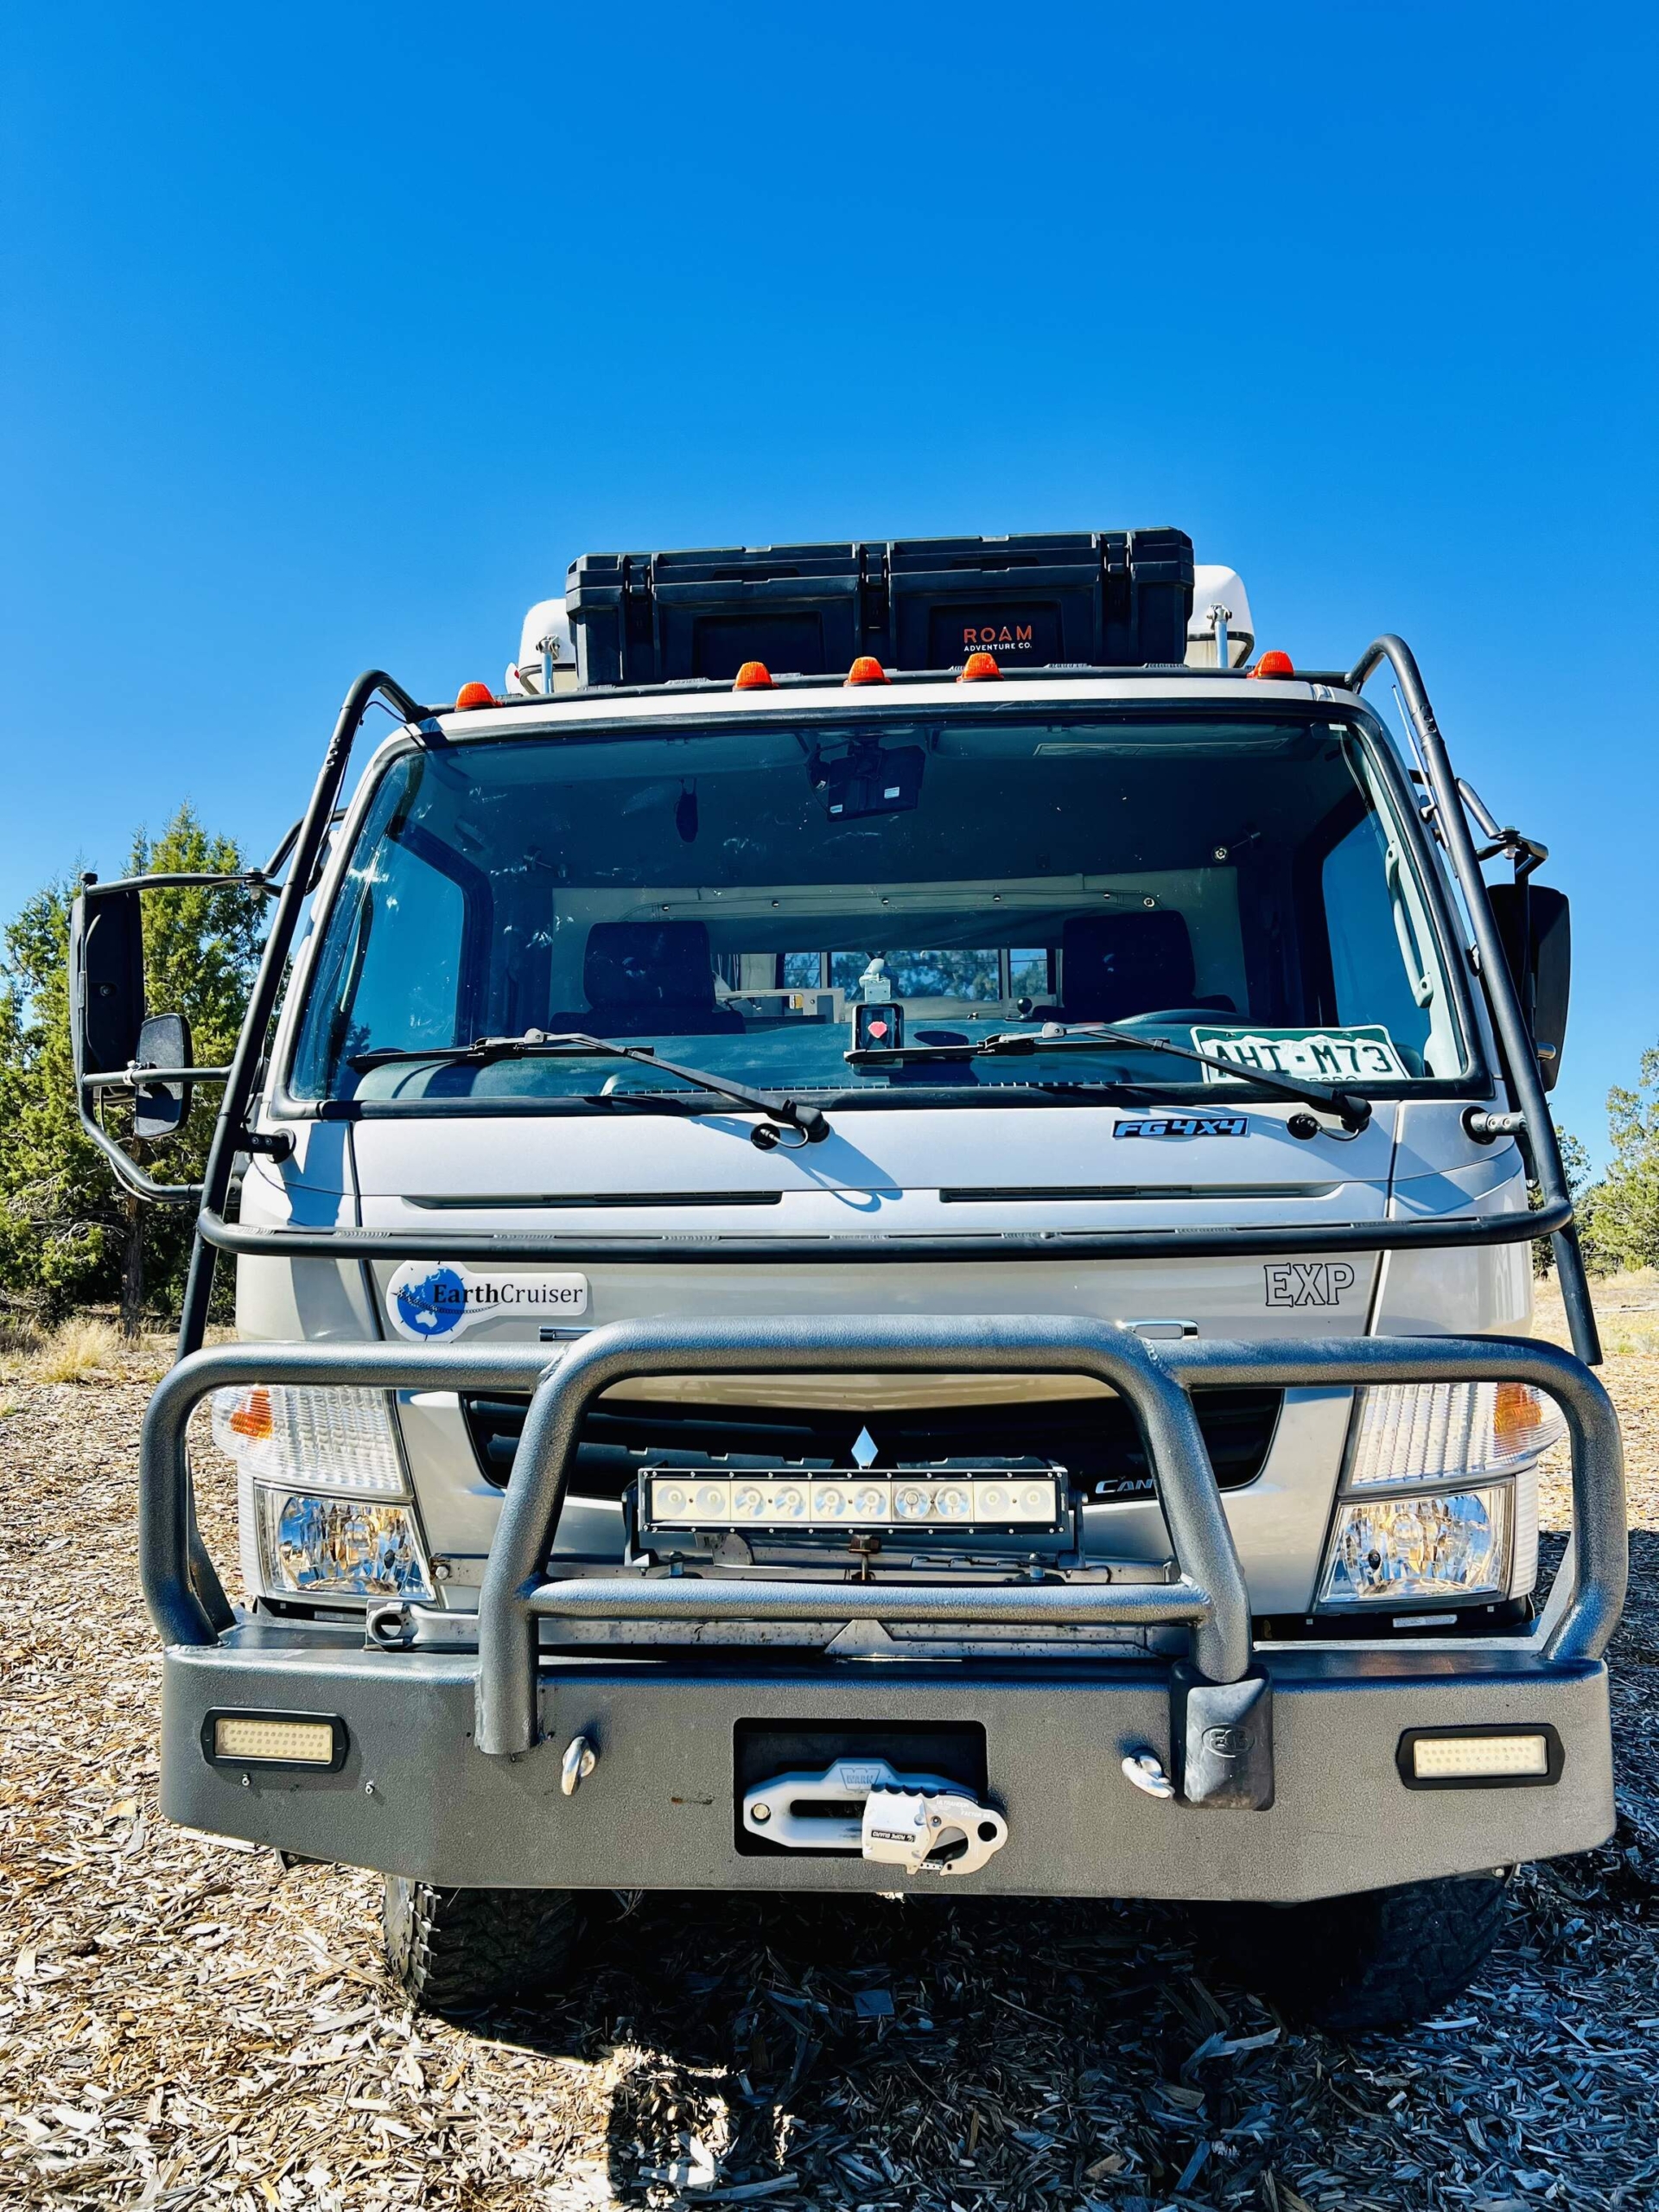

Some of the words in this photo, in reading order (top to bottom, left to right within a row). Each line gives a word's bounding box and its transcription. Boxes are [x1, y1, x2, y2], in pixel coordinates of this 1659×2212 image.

[963, 625, 1032, 644] ROAM
[963, 643, 1016, 652] ADVENTURE
[433, 1283, 583, 1303] EarthCruiser
[1263, 1262, 1355, 1307] EXP
[1095, 1478, 1154, 1494] CAN
[846, 1775, 874, 1784] WARN
